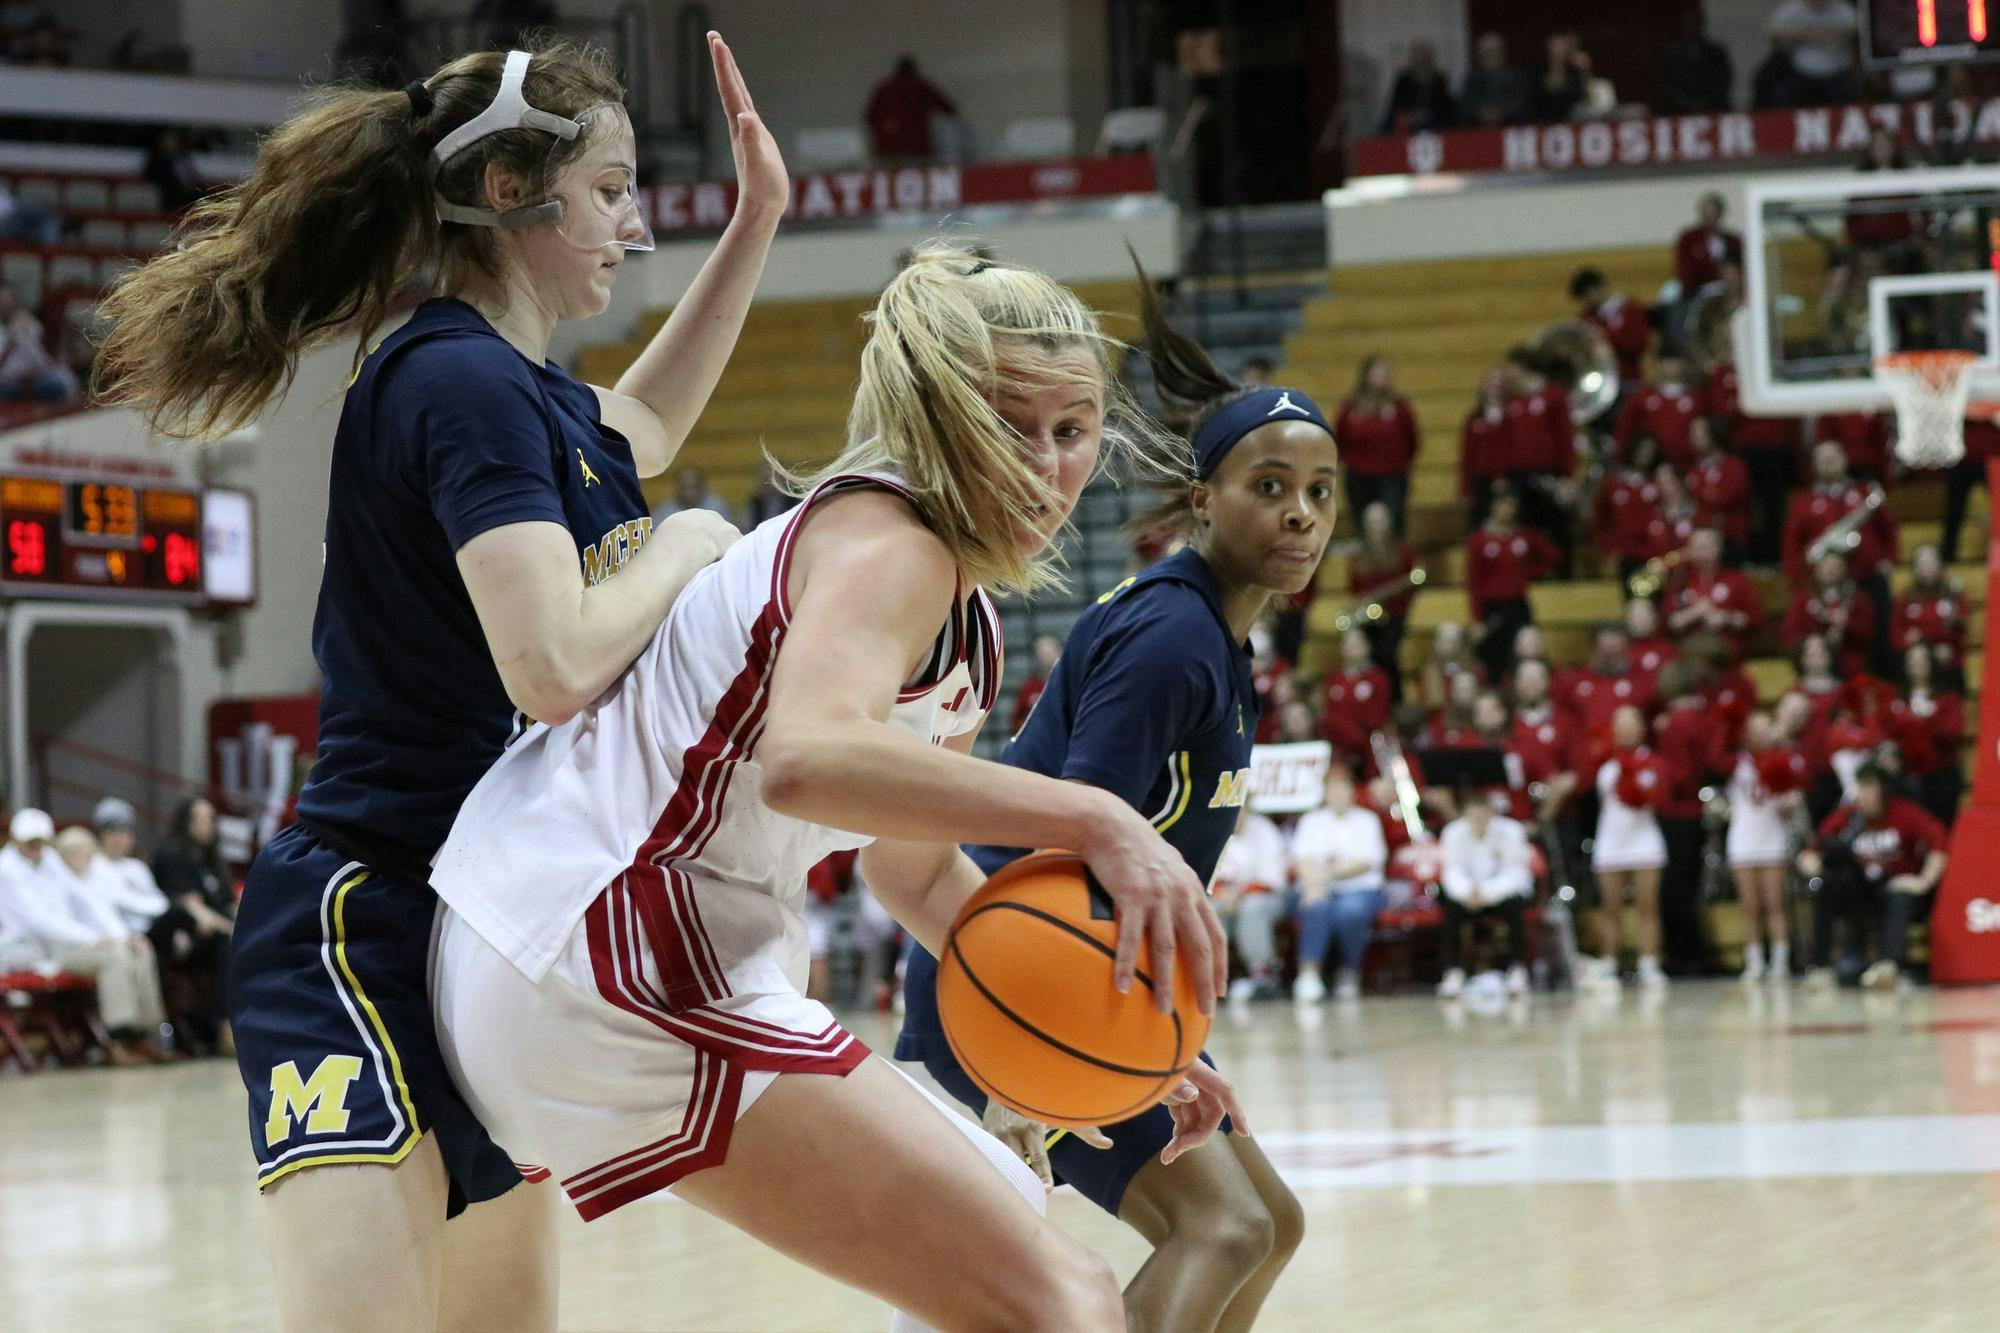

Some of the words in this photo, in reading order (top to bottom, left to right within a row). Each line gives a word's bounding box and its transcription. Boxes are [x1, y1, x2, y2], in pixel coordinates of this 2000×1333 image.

[1502, 113, 1754, 170] HOOSIER
[787, 166, 961, 217] ATION
[265, 1054, 364, 1149] M
